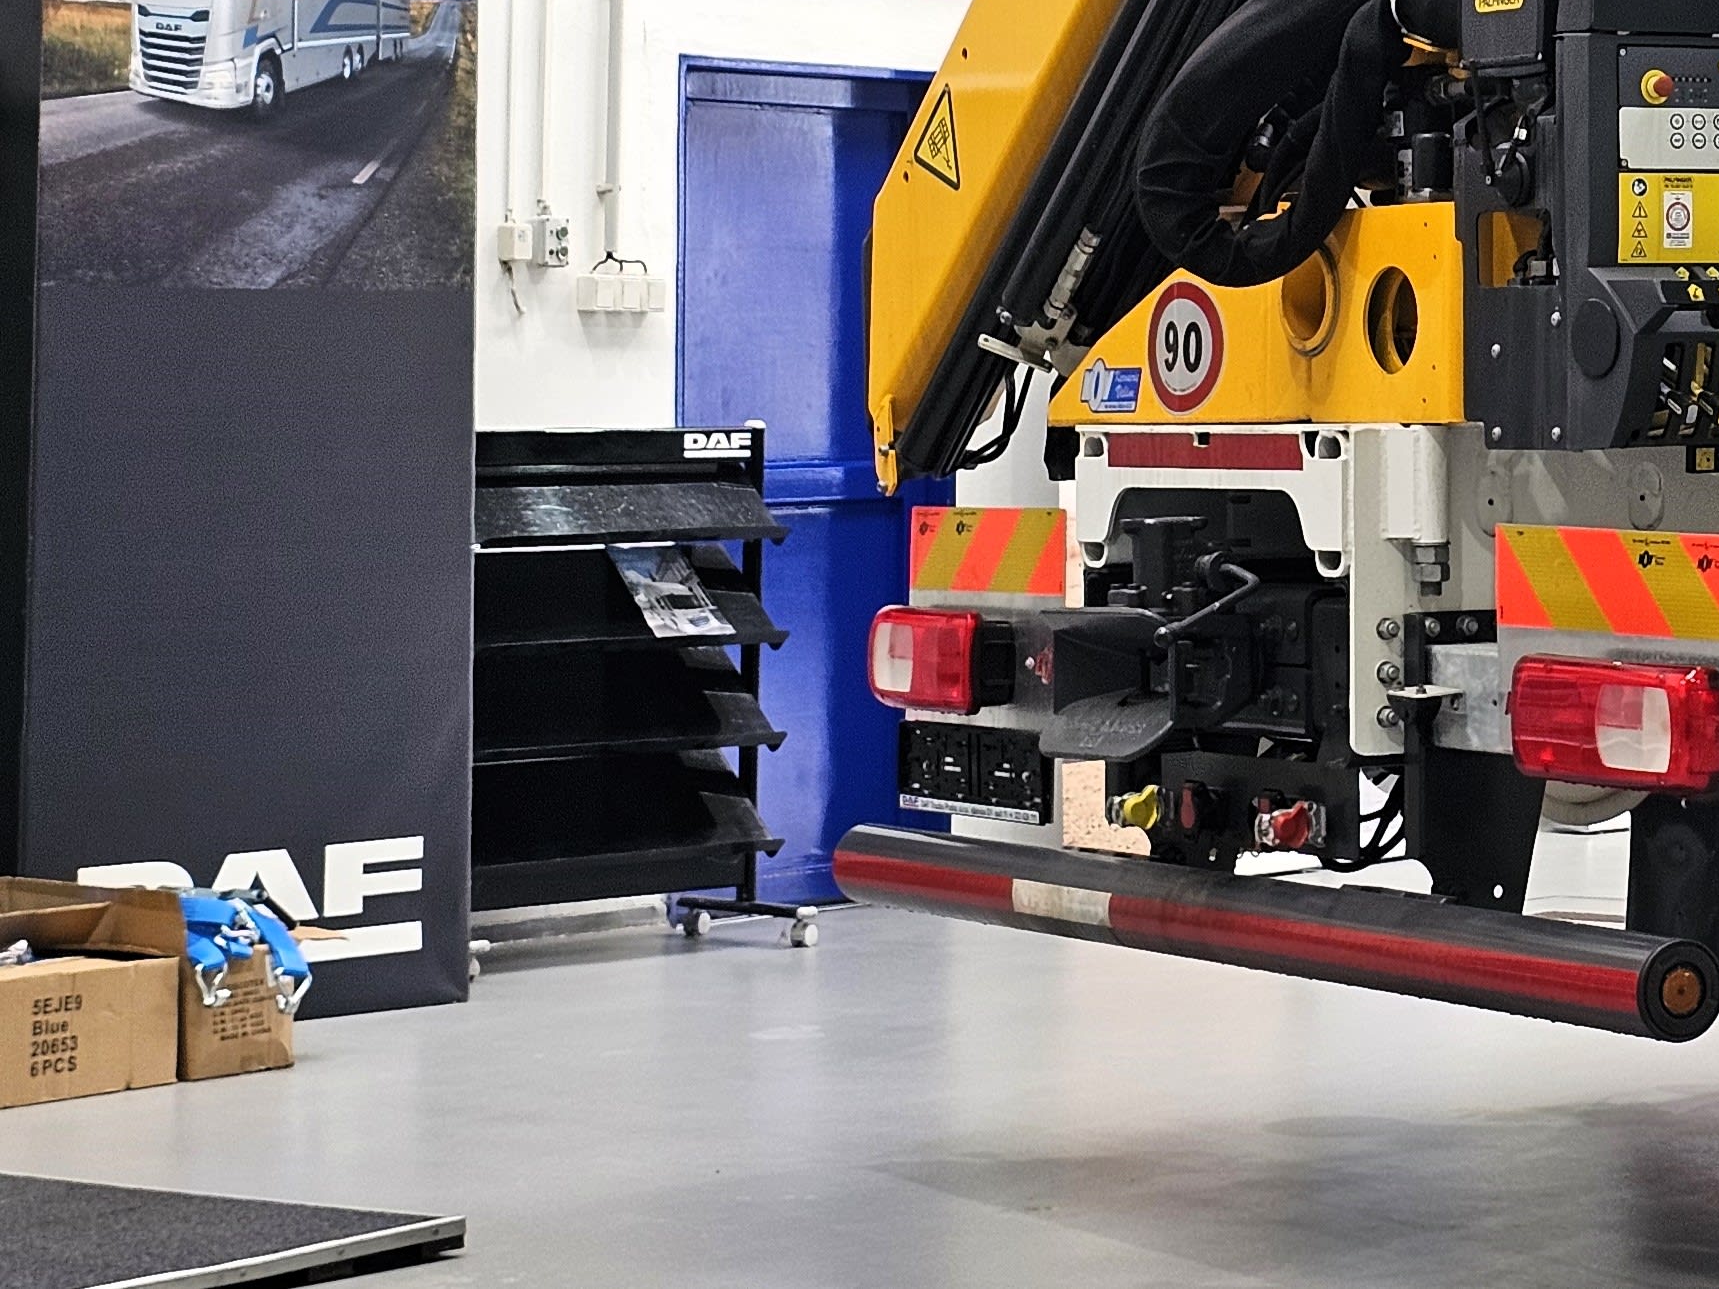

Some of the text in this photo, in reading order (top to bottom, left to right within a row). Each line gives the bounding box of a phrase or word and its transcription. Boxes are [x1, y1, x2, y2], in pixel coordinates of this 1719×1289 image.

[155, 21, 183, 32] DAF
[1164, 320, 1203, 374] 90
[683, 432, 752, 450] DAF
[77, 835, 424, 921] AF
[31, 993, 83, 1016] 5EJE9
[31, 1019, 69, 1037] Blue
[31, 1035, 79, 1057] 20653
[30, 1055, 78, 1078] 6PCS
